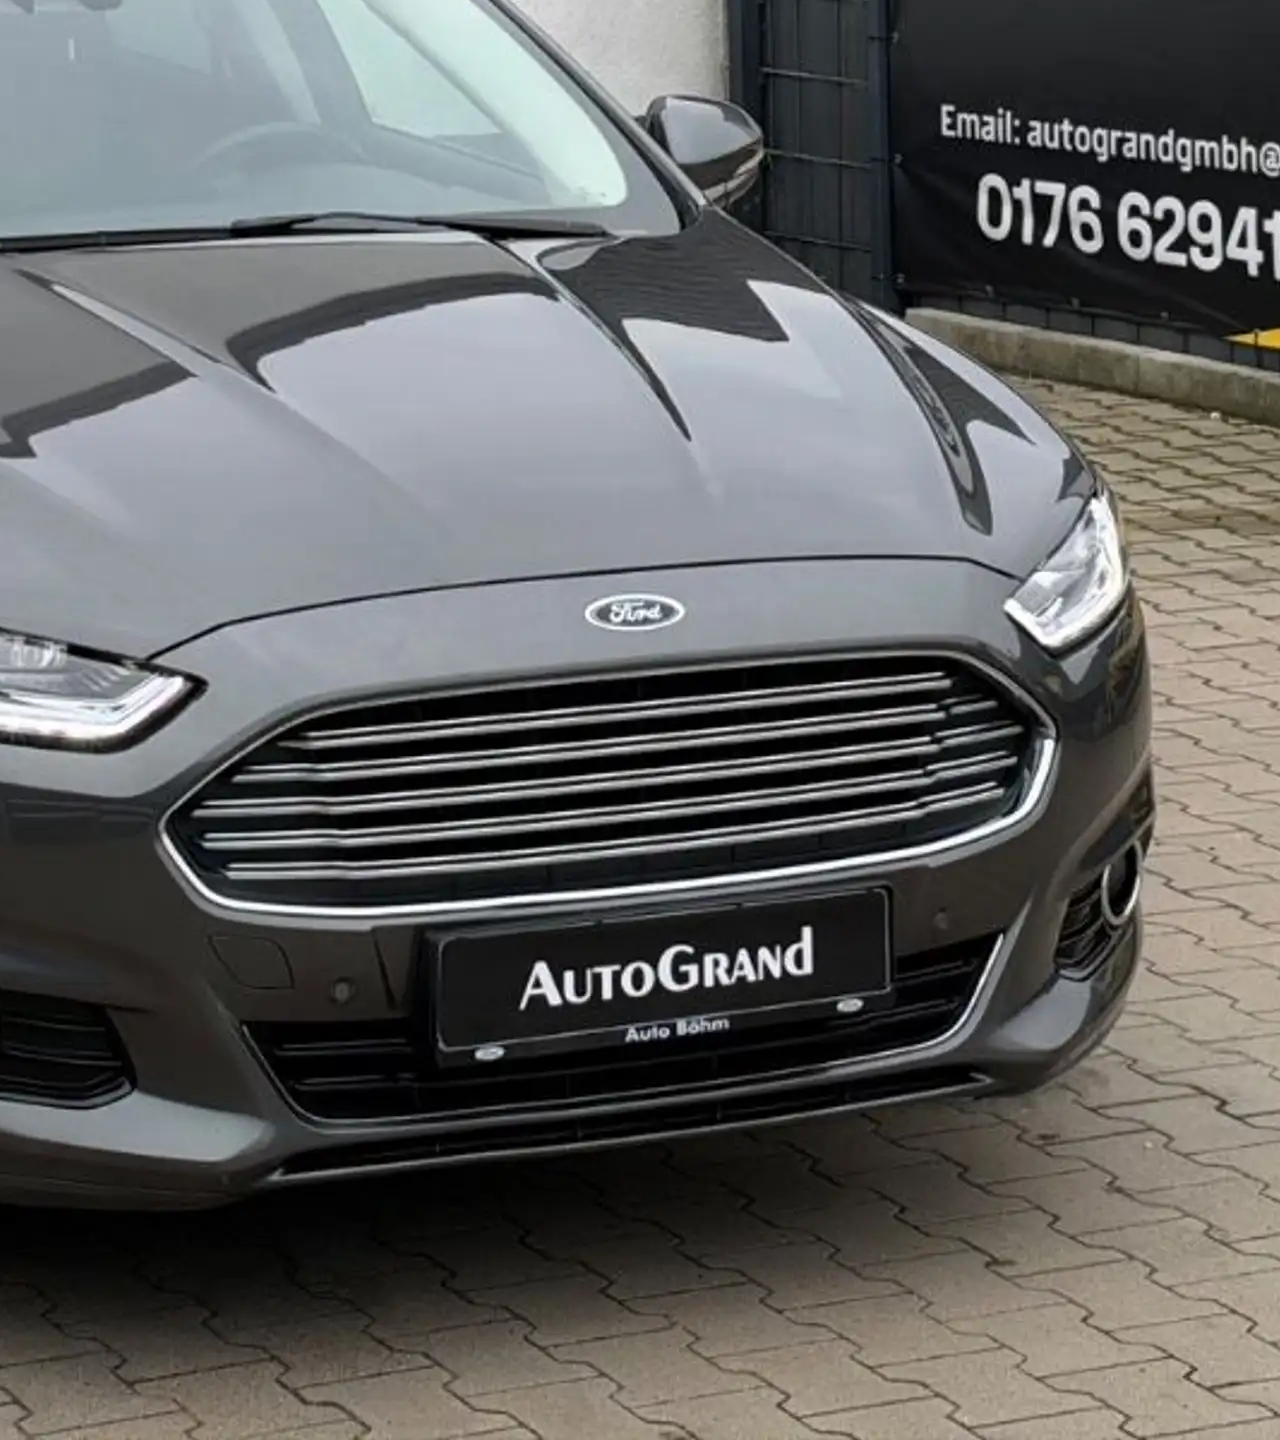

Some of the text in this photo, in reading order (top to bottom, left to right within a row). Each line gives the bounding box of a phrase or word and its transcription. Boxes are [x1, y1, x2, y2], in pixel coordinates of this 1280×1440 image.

[940, 104, 1021, 145] Email:
[977, 173, 1104, 253] 0176
[609, 600, 662, 622] Ford
[625, 1026, 670, 1043] Auto
